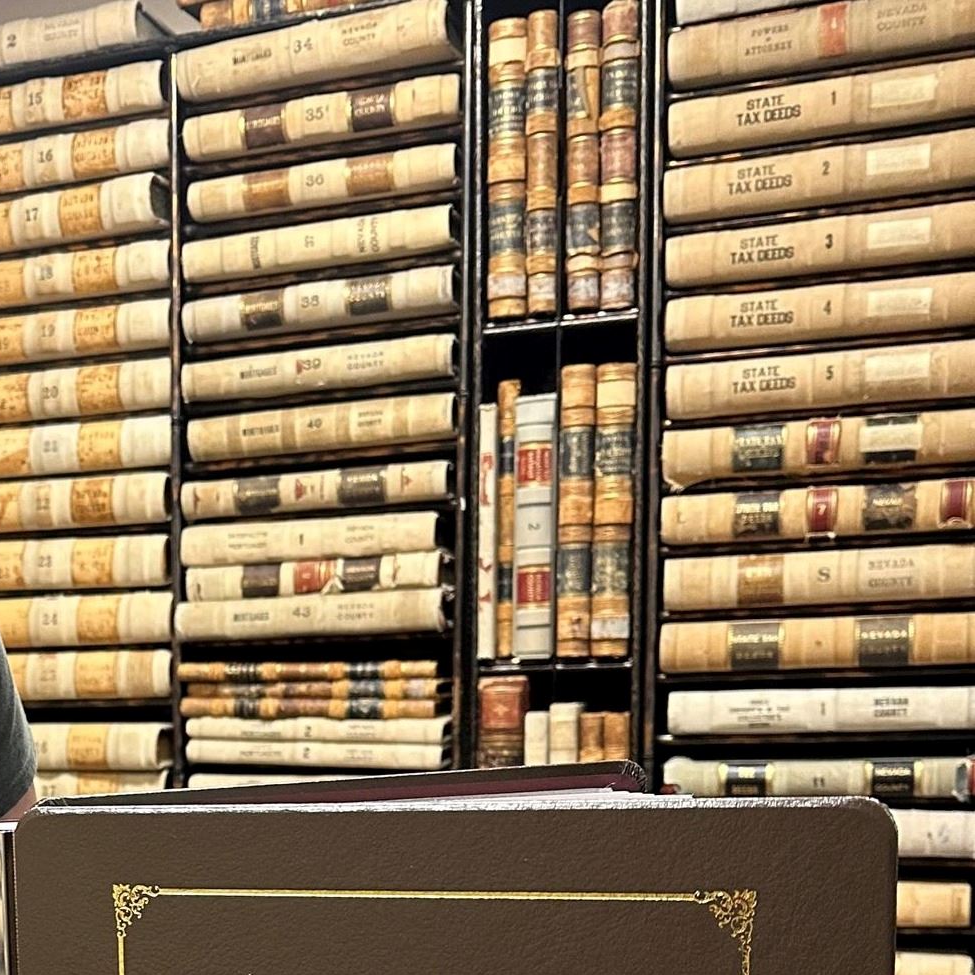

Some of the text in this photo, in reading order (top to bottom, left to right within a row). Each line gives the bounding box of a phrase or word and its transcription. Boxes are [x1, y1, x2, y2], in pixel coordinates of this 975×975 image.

[877, 3, 928, 19] NEVADA
[877, 15, 926, 32] COUNTY
[6, 34, 17, 48] 2
[293, 37, 313, 54] 34
[343, 32, 377, 47] COUNTY
[28, 91, 43, 106] 15
[746, 94, 785, 111] STATE
[830, 90, 836, 106] 1
[736, 105, 801, 126] TAX DEEDS
[38, 149, 53, 164] 16
[737, 164, 776, 180] STATE
[822, 161, 830, 176] 2
[728, 175, 793, 196] TAX DEEDS
[25, 207, 39, 222] 17
[740, 234, 779, 249] STATE
[825, 233, 833, 249] 3
[730, 247, 794, 265] TAX DEEDS
[39, 265, 54, 281] 18
[301, 295, 319, 308] 38
[740, 299, 778, 313] STATE
[823, 300, 832, 315] 4
[730, 311, 794, 328] TAX DEEDS
[40, 323, 56, 338] 19
[302, 358, 322, 371] 39
[346, 360, 384, 371] COUNTY
[742, 366, 780, 379] STATE
[826, 365, 834, 380] 5
[40, 385, 60, 400] 20
[733, 377, 796, 394] TAX DEEDS
[307, 418, 322, 429] 40
[817, 566, 831, 583] S
[42, 612, 58, 626] 24
[293, 606, 311, 618] 43
